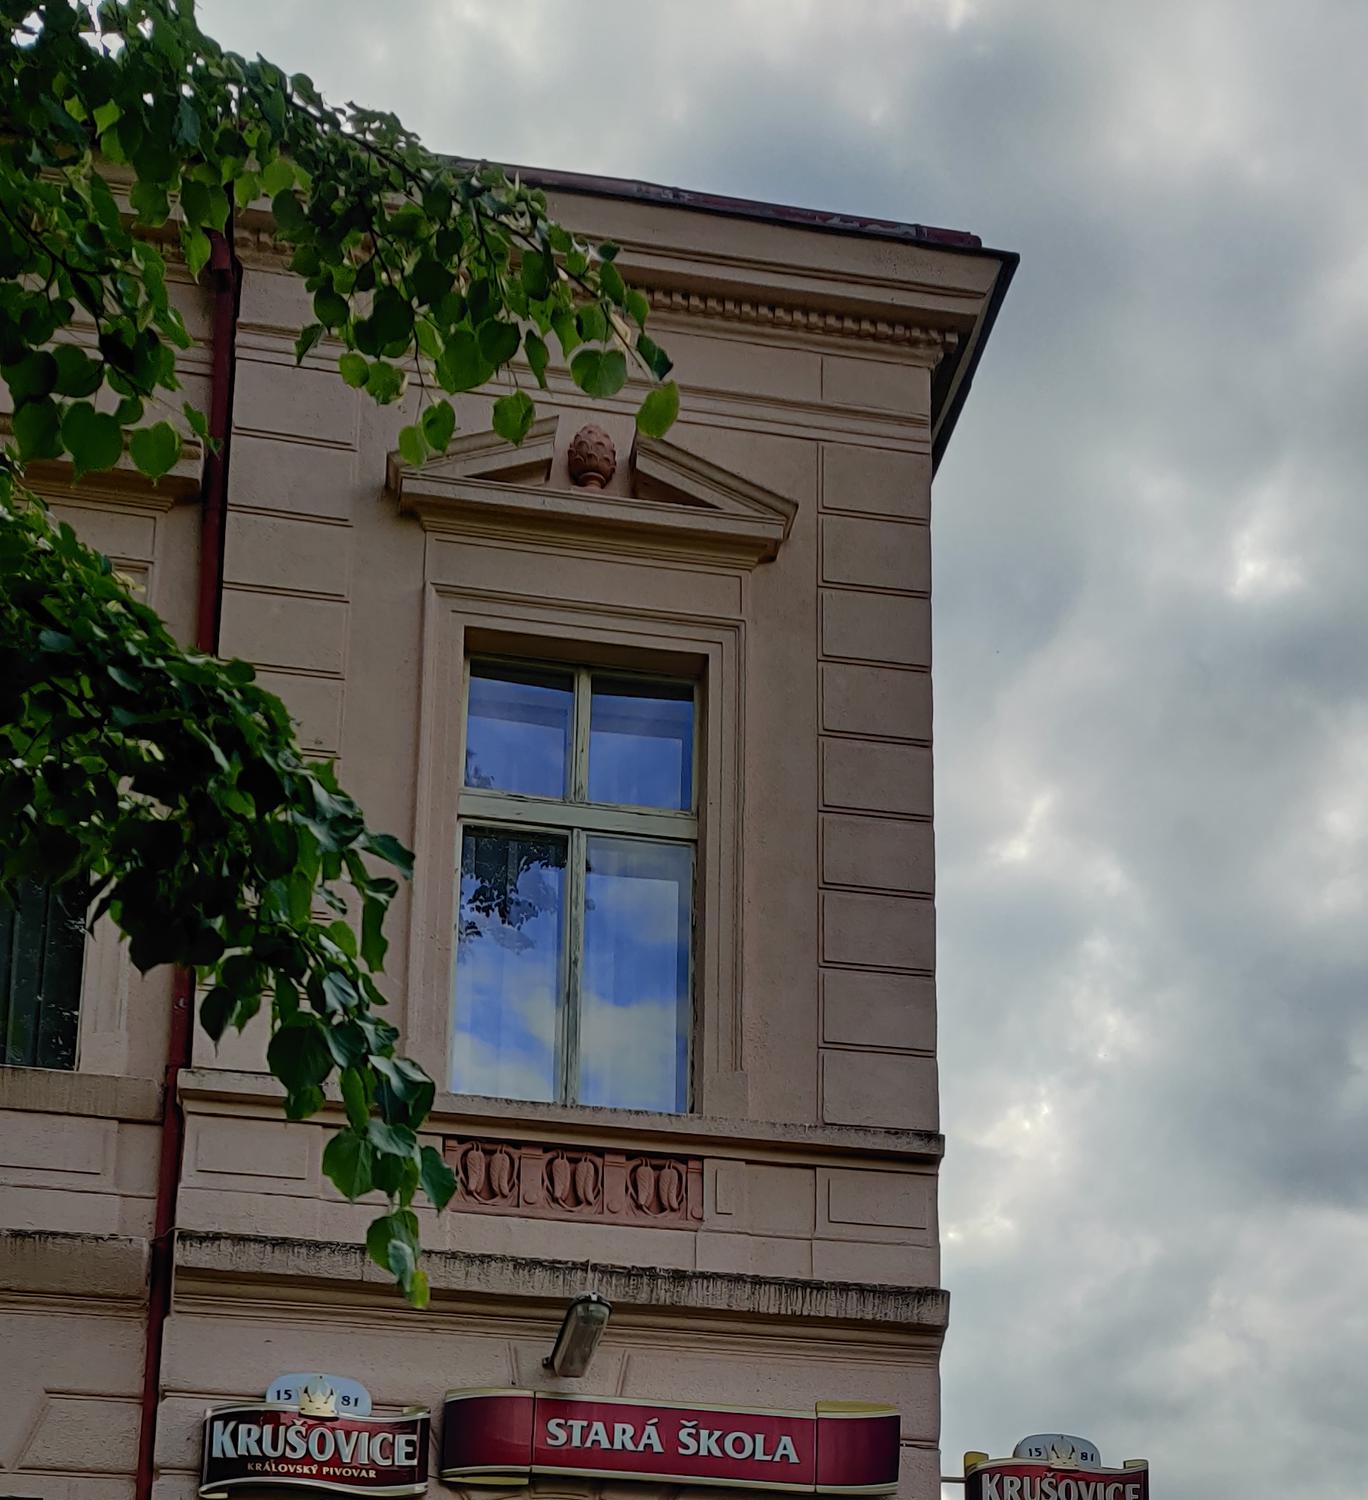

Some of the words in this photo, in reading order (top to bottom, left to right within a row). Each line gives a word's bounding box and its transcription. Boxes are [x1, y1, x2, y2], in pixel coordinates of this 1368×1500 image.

[275, 1389, 293, 1401] 15
[341, 1395, 359, 1408] 81
[211, 1418, 419, 1467] KRUŠOVICE
[546, 1417, 664, 1453] STARÁ
[677, 1419, 801, 1464] ŠKOLA
[1027, 1447, 1043, 1457] 15
[1080, 1451, 1095, 1462] 81
[247, 1459, 318, 1475] KRÁLOVSKÝ
[322, 1466, 377, 1479] PIVOVAR
